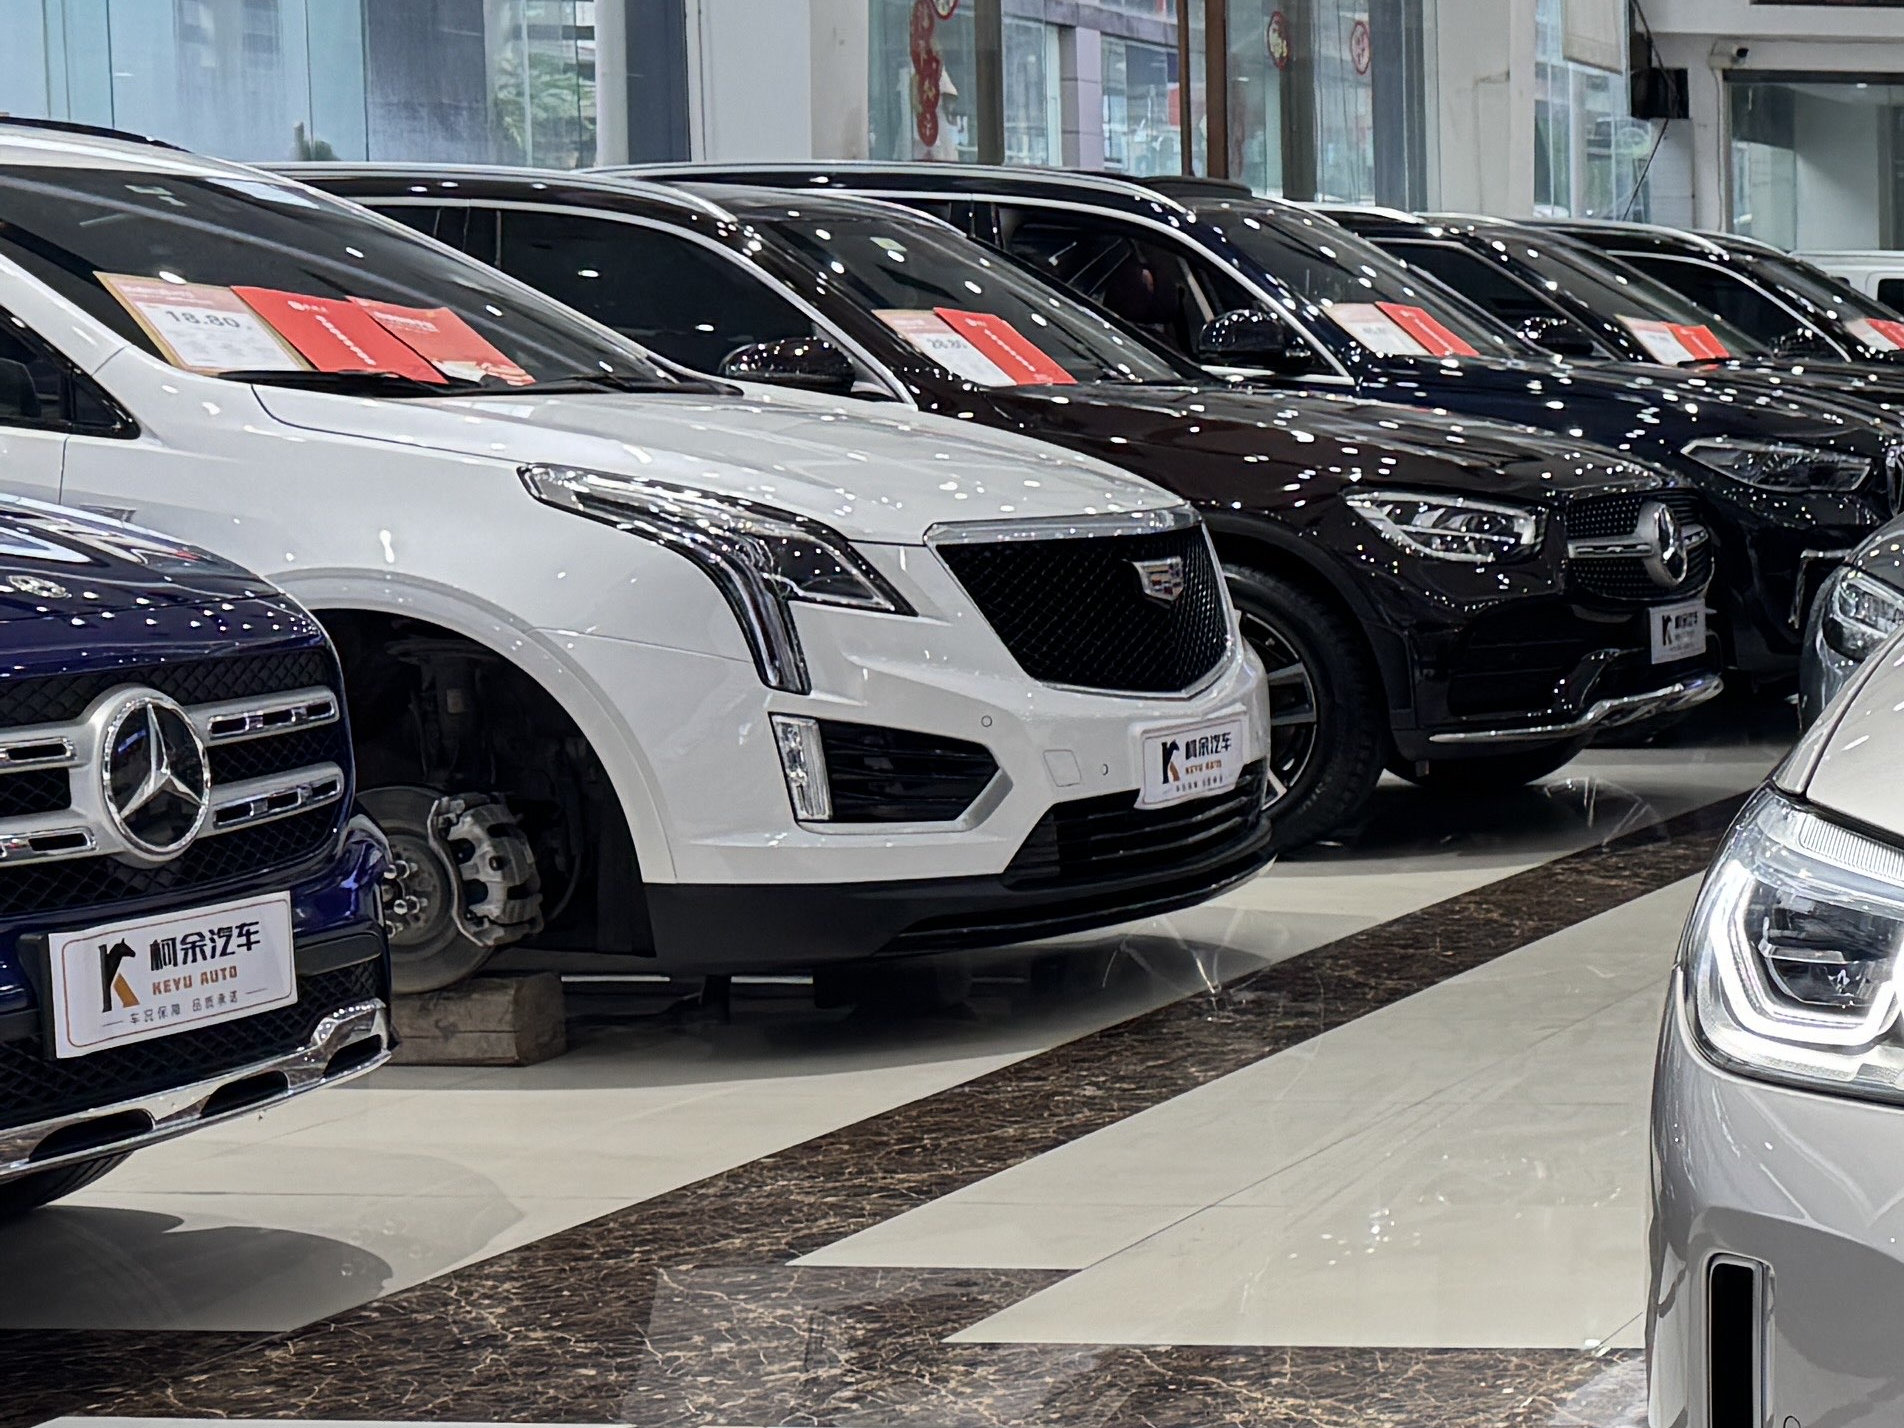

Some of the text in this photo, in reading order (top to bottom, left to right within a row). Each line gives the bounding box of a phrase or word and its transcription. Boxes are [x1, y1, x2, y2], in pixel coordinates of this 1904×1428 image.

[150, 921, 261, 972] 柯余汽车
[152, 965, 238, 996] KEYU AUTO
